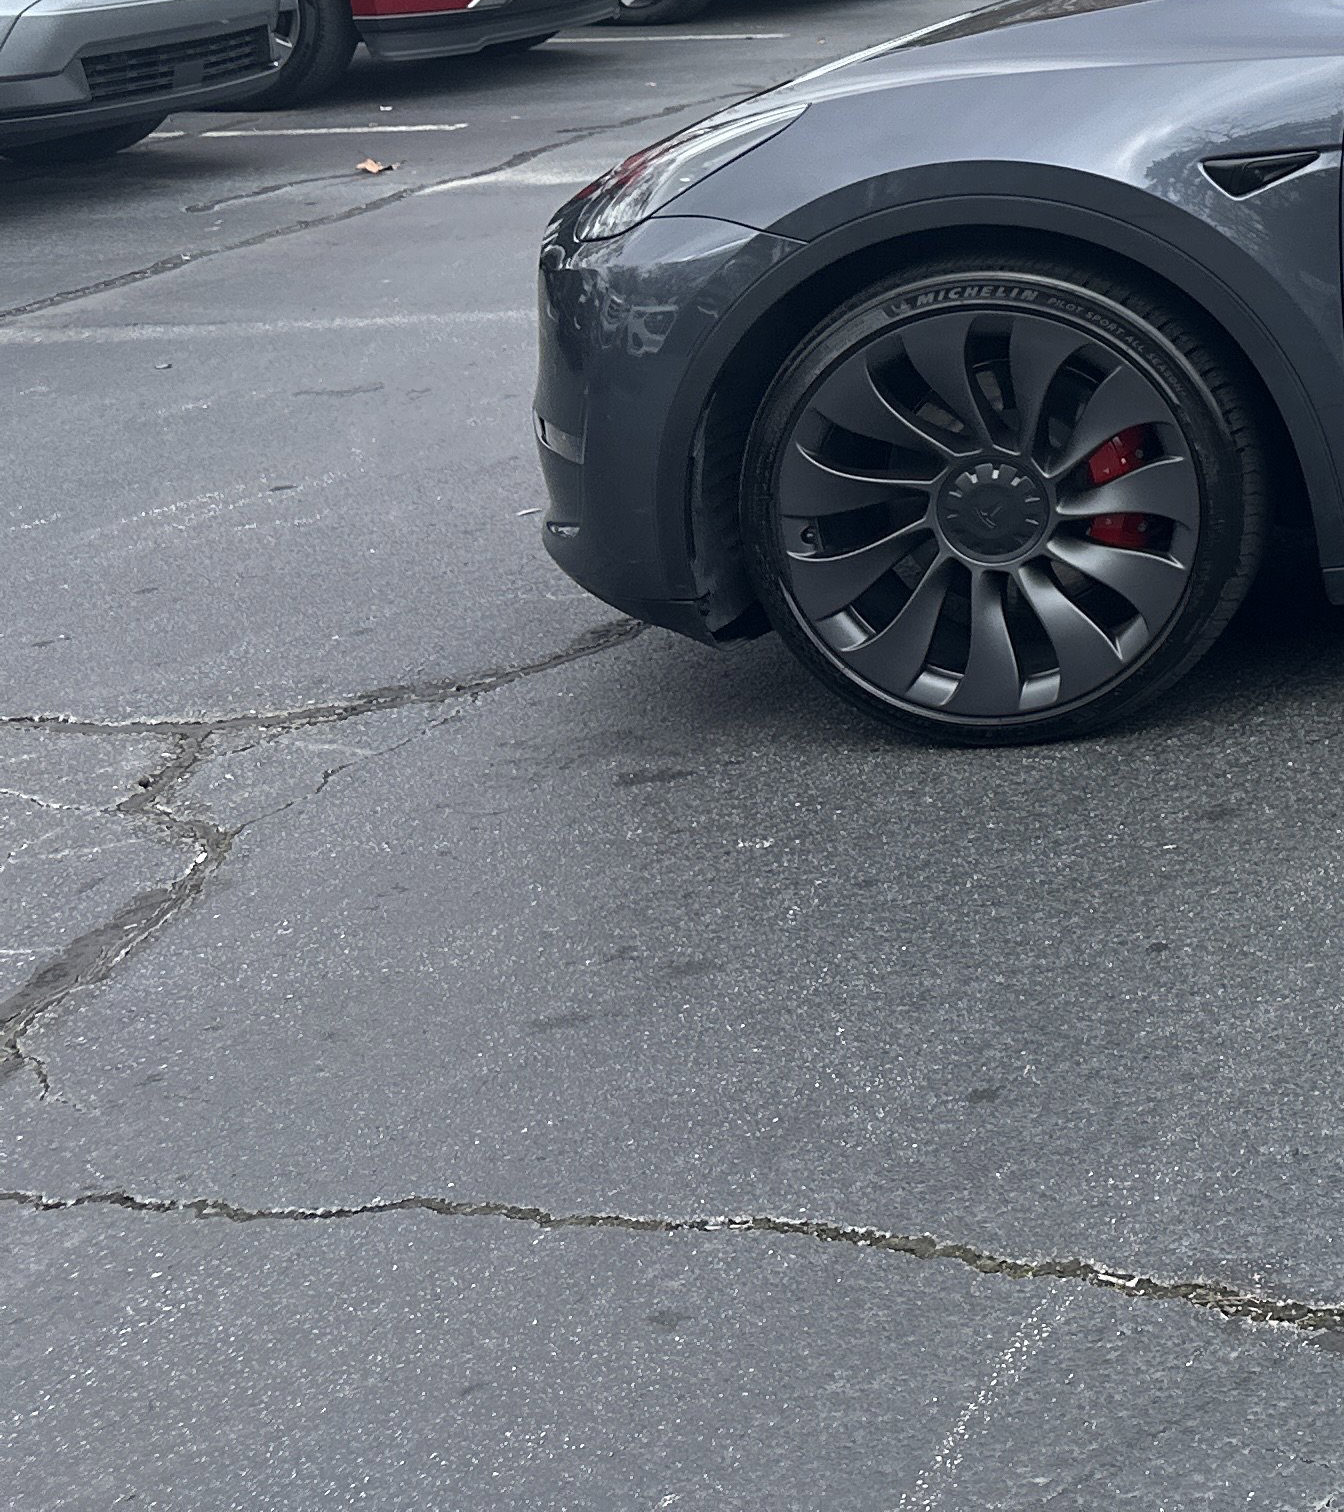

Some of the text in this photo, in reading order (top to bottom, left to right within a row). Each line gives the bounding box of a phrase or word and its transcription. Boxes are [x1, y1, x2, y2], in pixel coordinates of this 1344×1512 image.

[917, 287, 1038, 306] MICHELIN
[1048, 296, 1085, 314] PILOT
[1085, 311, 1126, 335] SPORT
[1125, 335, 1145, 354] ALL
